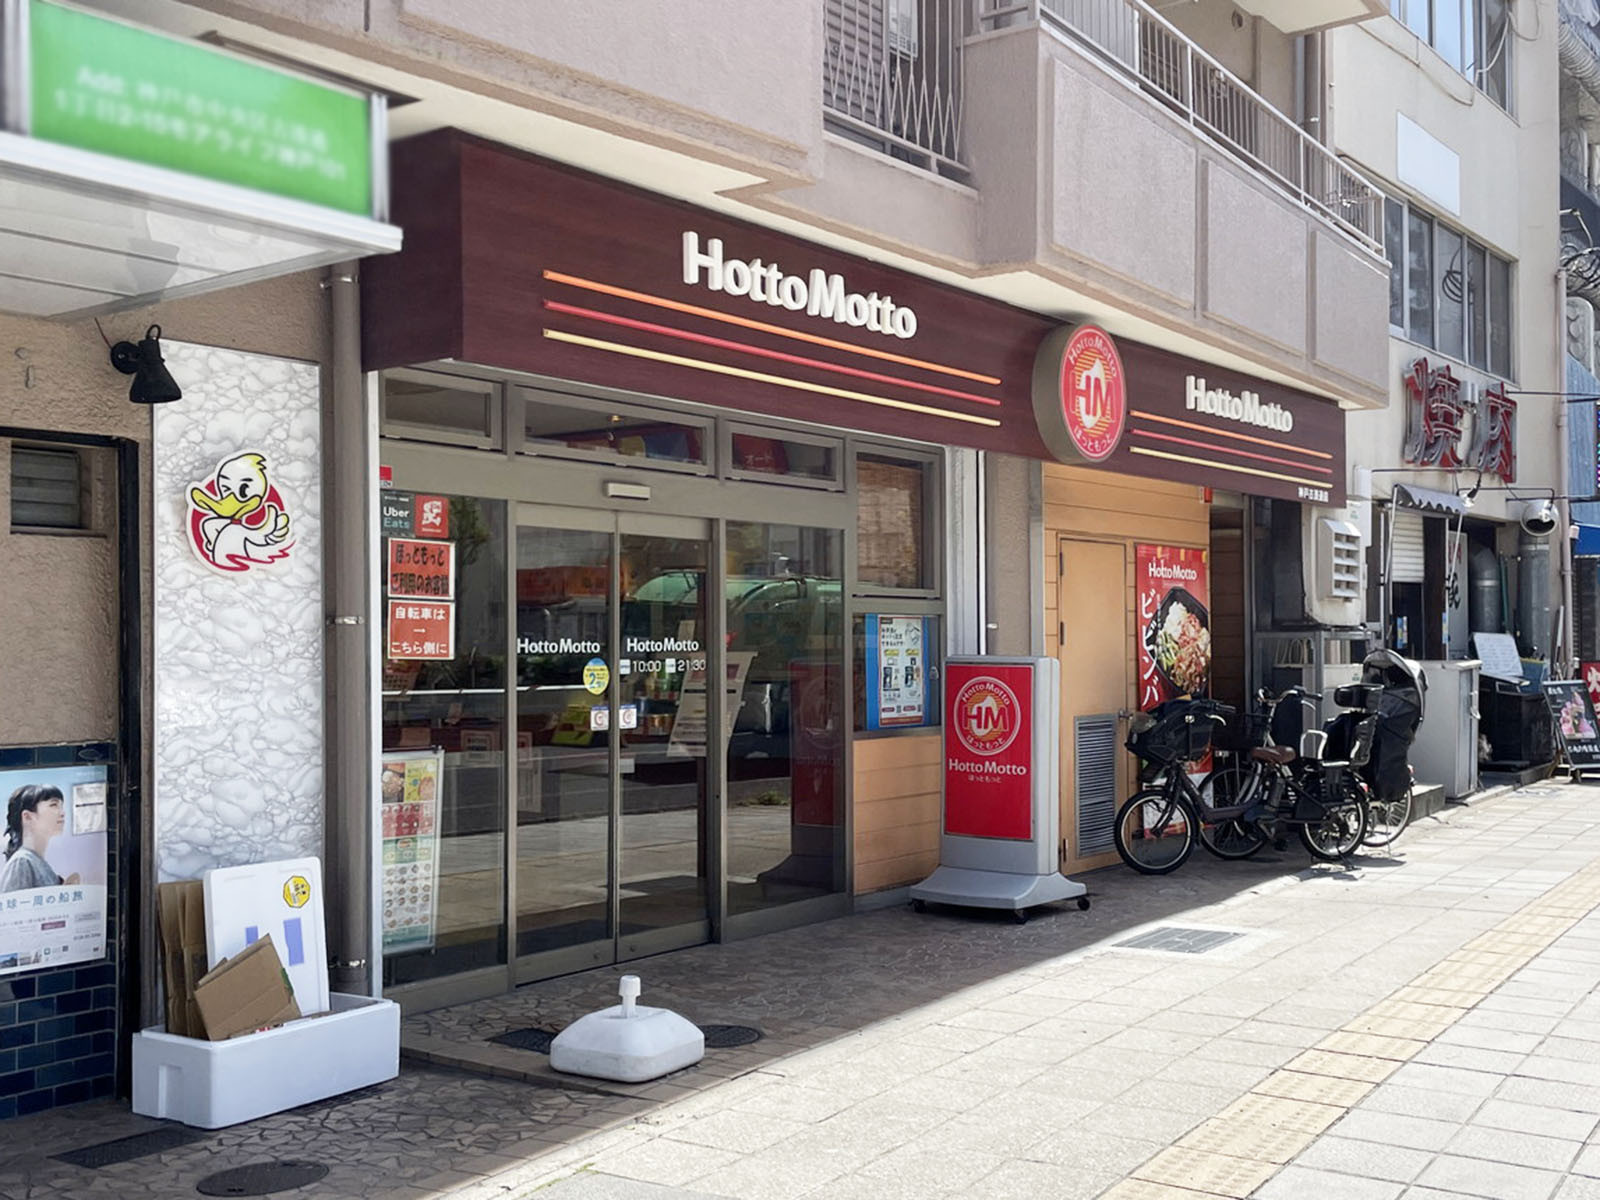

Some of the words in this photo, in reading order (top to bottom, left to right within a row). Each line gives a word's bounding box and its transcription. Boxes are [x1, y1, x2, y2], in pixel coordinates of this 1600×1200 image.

[683, 231, 917, 339] HottoMotto
[1186, 375, 1293, 432] HottoMotto
[383, 506, 410, 518] Uber
[384, 517, 410, 529] Eats
[395, 543, 445, 567] ほっともっと
[1148, 562, 1197, 581] HottoMotto
[392, 572, 449, 595] ご利用のお客様
[395, 606, 446, 620] 自転車は
[391, 641, 448, 655] こちら側に
[517, 638, 600, 654] HottoMotto
[627, 637, 699, 653] HottoMotto
[1141, 588, 1160, 707] ビビンバ
[632, 660, 662, 673] 10:00
[677, 659, 706, 672] 21:30
[967, 735, 1006, 750] ほっともっと
[949, 758, 1027, 776] HottoMotto
